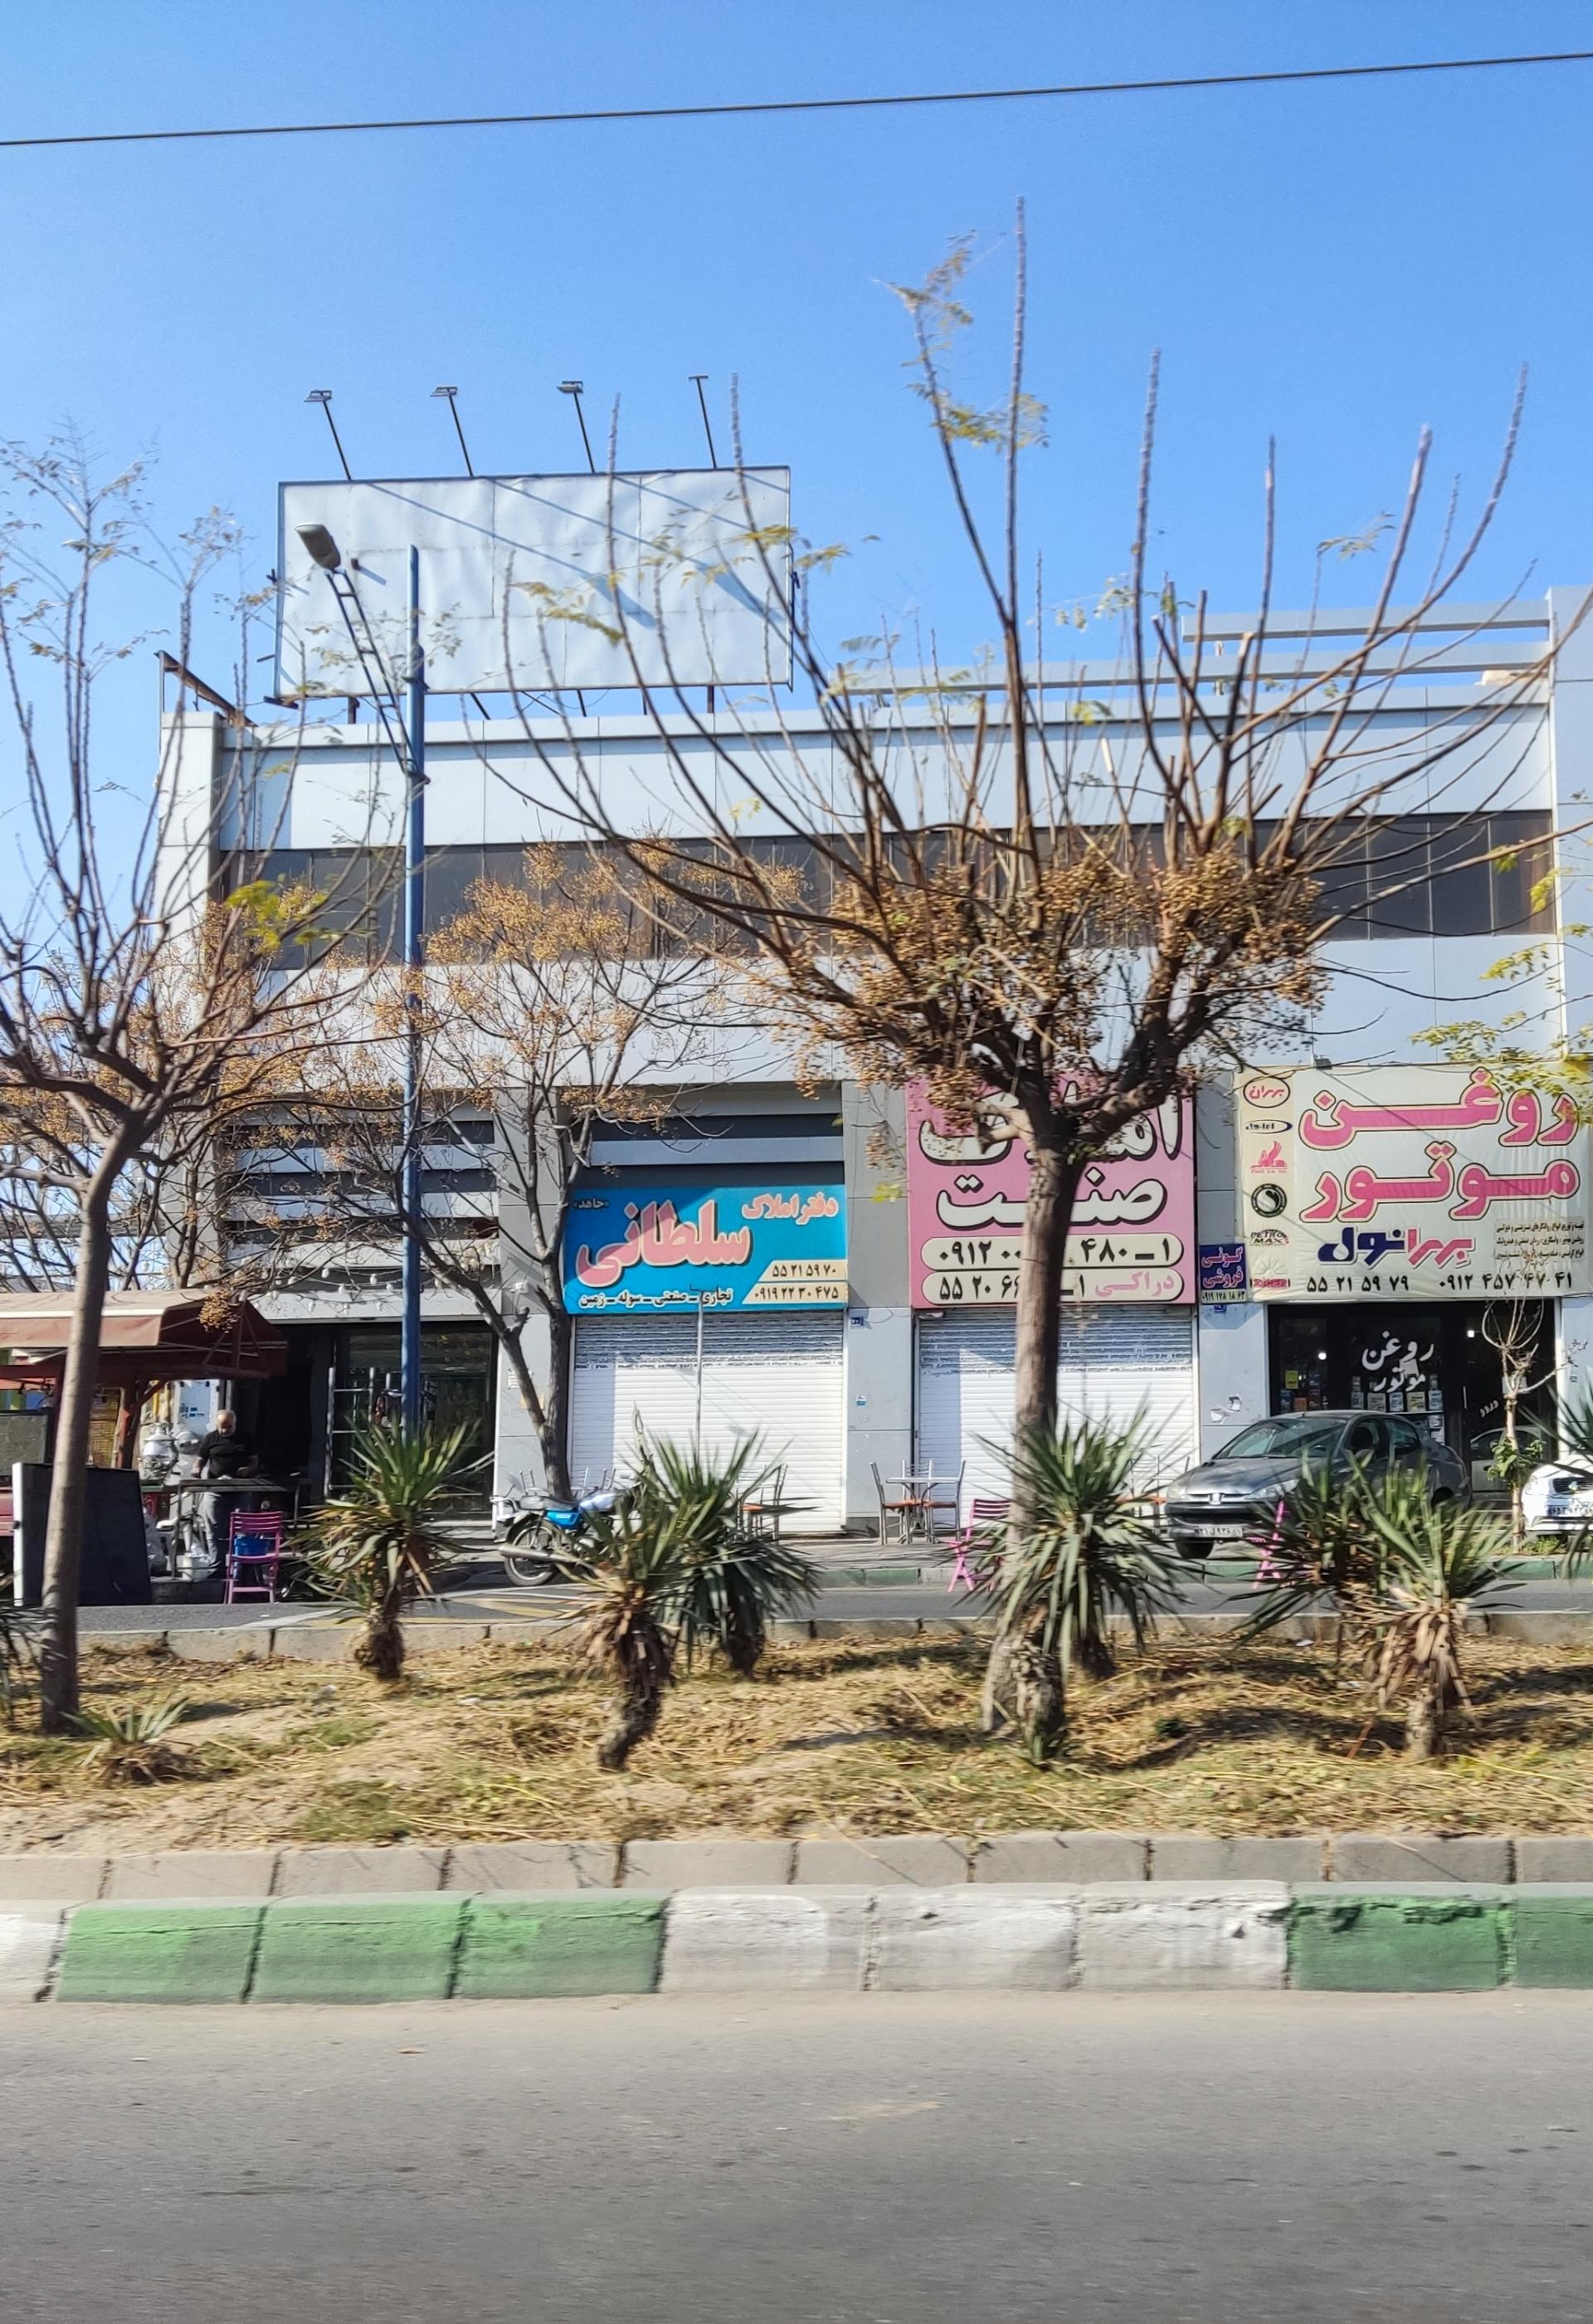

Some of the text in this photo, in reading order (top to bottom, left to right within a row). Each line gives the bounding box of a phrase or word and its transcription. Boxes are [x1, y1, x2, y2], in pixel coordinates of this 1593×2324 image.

[1298, 1066, 1579, 1151] روغن
[1299, 1142, 1581, 1223] موتور
[741, 1191, 839, 1225] دفتر املاک
[936, 1166, 1168, 1231] صنت
[575, 1199, 751, 1288] سلطانی
[939, 1240, 991, 1265] ۰۹۱۲
[772, 1264, 787, 1278] ۵۵
[1202, 1265, 1244, 1289] فروشی
[1307, 1276, 1328, 1293] ۵۵
[1336, 1275, 1352, 1292] ۲۱
[1362, 1275, 1381, 1292] ۵۹
[1389, 1275, 1410, 1292] ۷۹
[1439, 1274, 1474, 1290] ۰۹۱۲
[1554, 1272, 1573, 1289] ۴۱
[578, 1291, 606, 1309] زمین
[617, 1289, 642, 1308] سوله
[654, 1289, 688, 1308] صنعتی
[939, 1276, 963, 1300] ۵۵
[972, 1275, 991, 1299] ۲۰
[1362, 1330, 1435, 1371] روغن
